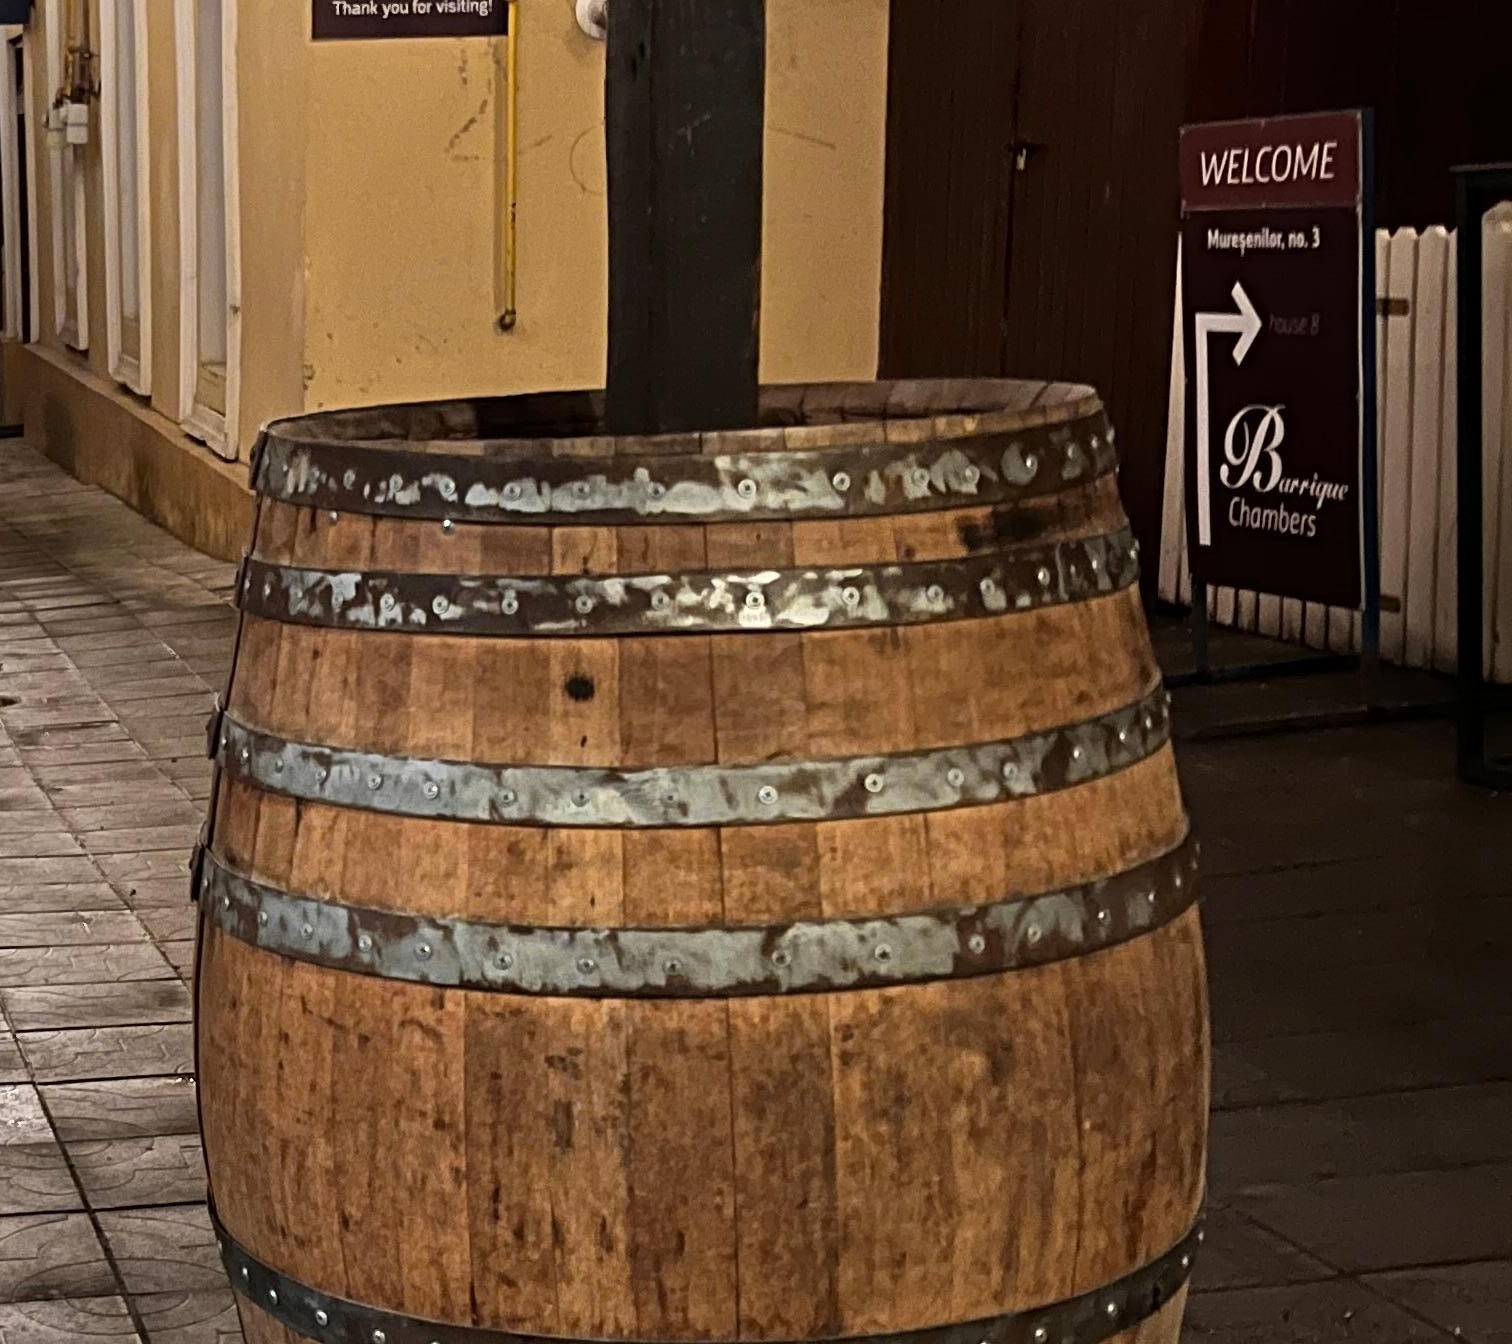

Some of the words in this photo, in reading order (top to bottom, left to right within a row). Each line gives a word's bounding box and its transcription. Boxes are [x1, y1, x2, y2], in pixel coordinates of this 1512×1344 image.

[332, 0, 378, 15] Thank
[382, 2, 409, 19] you
[412, 0, 432, 14] for
[1200, 141, 1338, 186] WELCOME
[1288, 231, 1310, 250] no.
[1311, 226, 1321, 249] 3
[1269, 314, 1307, 336] house
[1219, 404, 1349, 510] Barrique
[1228, 496, 1317, 538] Chambers
